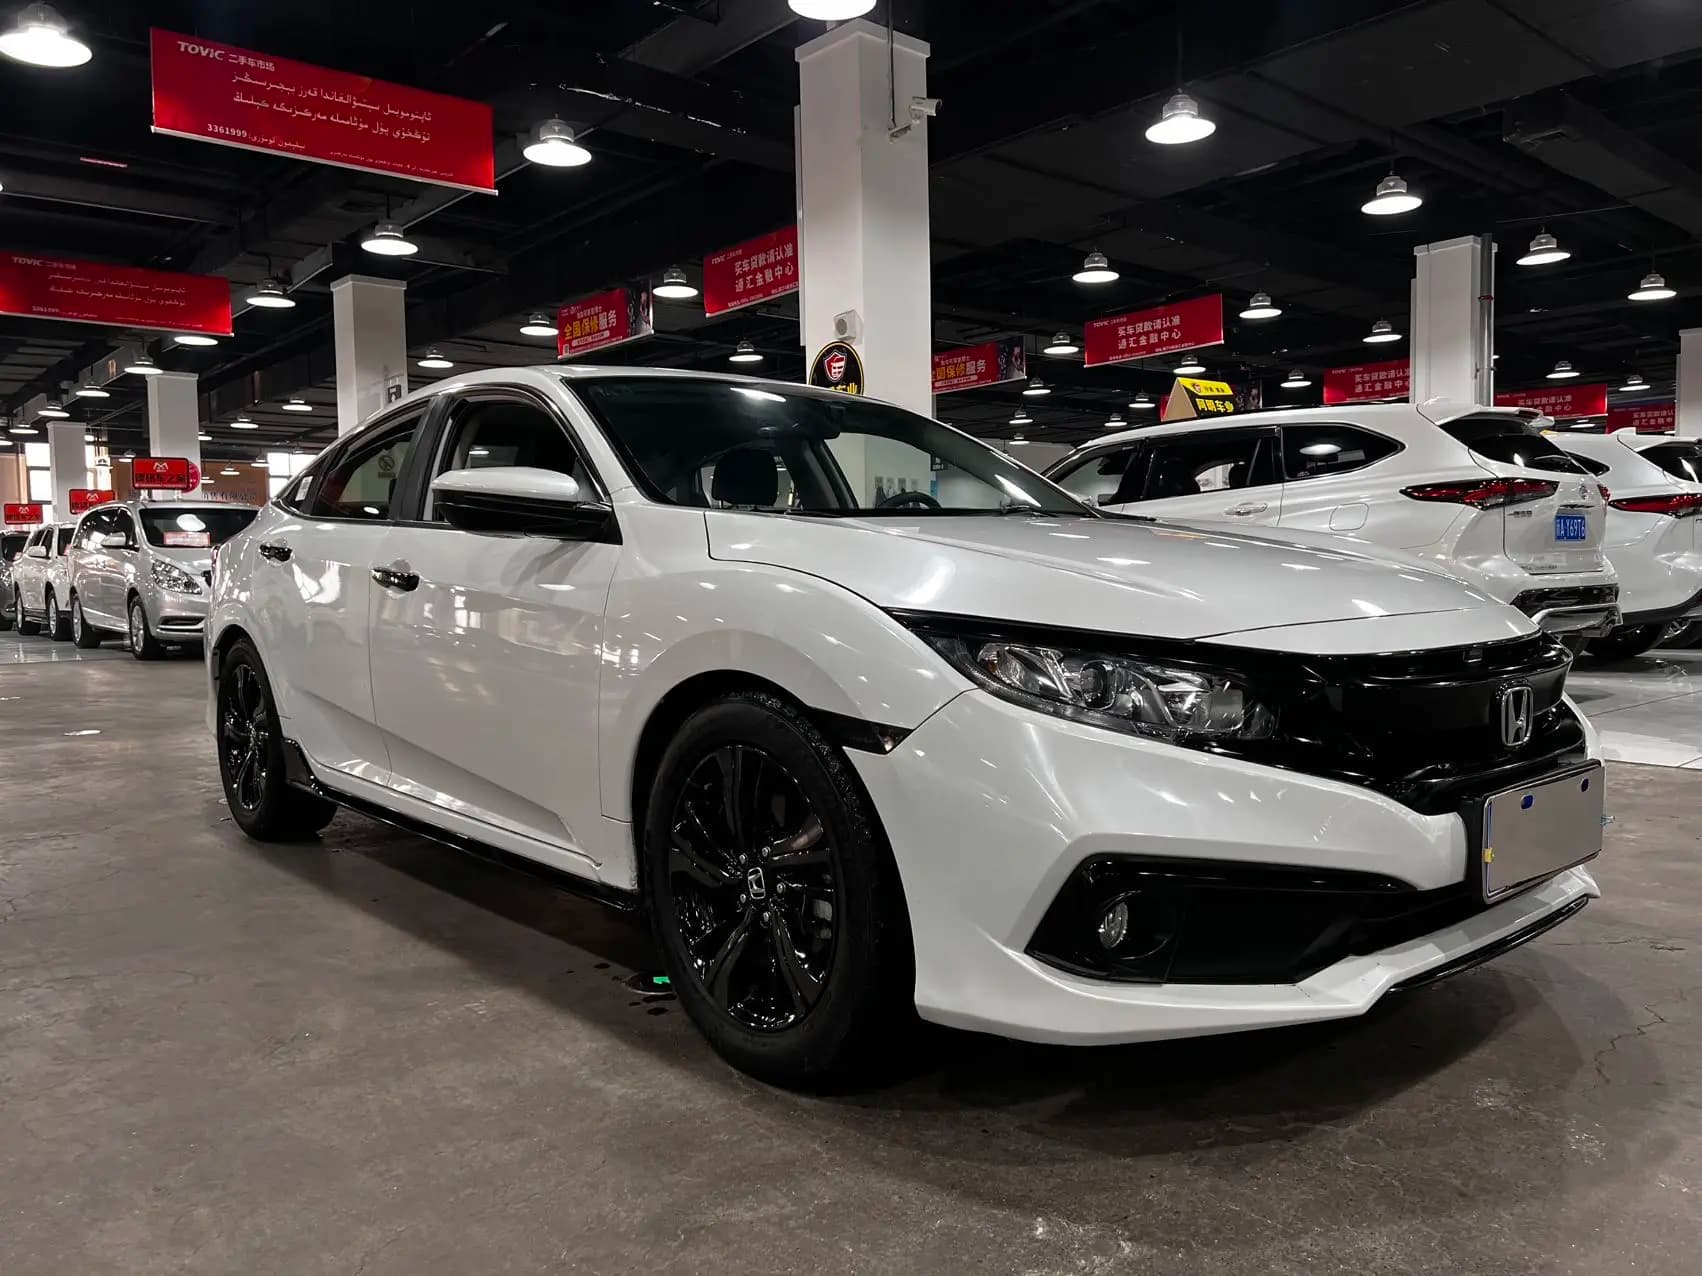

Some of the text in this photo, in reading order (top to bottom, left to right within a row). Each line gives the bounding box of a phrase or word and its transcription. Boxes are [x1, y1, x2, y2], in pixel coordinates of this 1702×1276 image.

[177, 41, 276, 72] TOVIC 二手车市场
[207, 123, 248, 138] 3361999
[734, 242, 794, 276] 买车贷款请认准
[735, 262, 794, 293] 通汇金融中心
[564, 309, 617, 340] 全国保修服务
[1117, 315, 1181, 337] 买车贷款请认准
[1118, 329, 1182, 350] 通汇金融中心
[932, 360, 987, 381] 国保修服务
